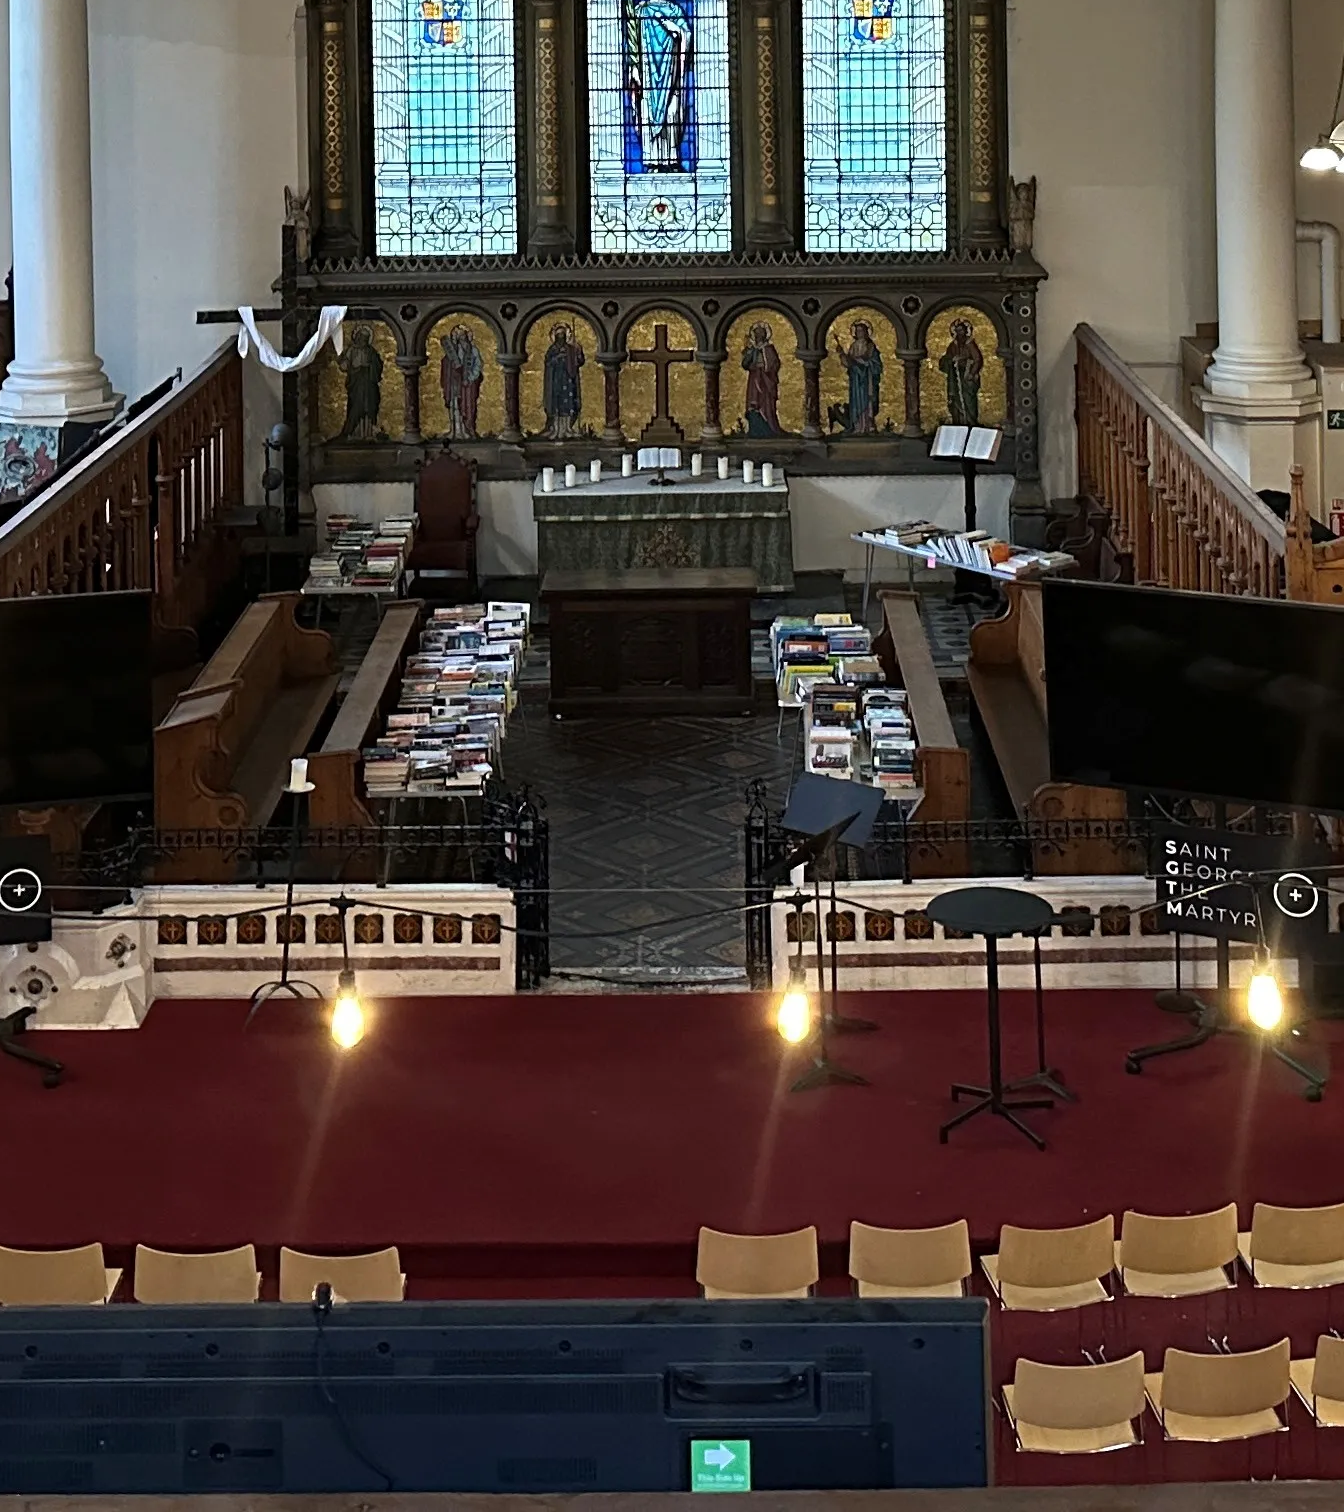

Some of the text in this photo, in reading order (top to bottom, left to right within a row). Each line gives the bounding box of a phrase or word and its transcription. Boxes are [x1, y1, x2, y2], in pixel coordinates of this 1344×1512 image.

[1165, 840, 1232, 863] SAINT
[1165, 860, 1256, 883] GEORG
[1165, 880, 1209, 901] THE
[1166, 901, 1256, 928] MARTYR
